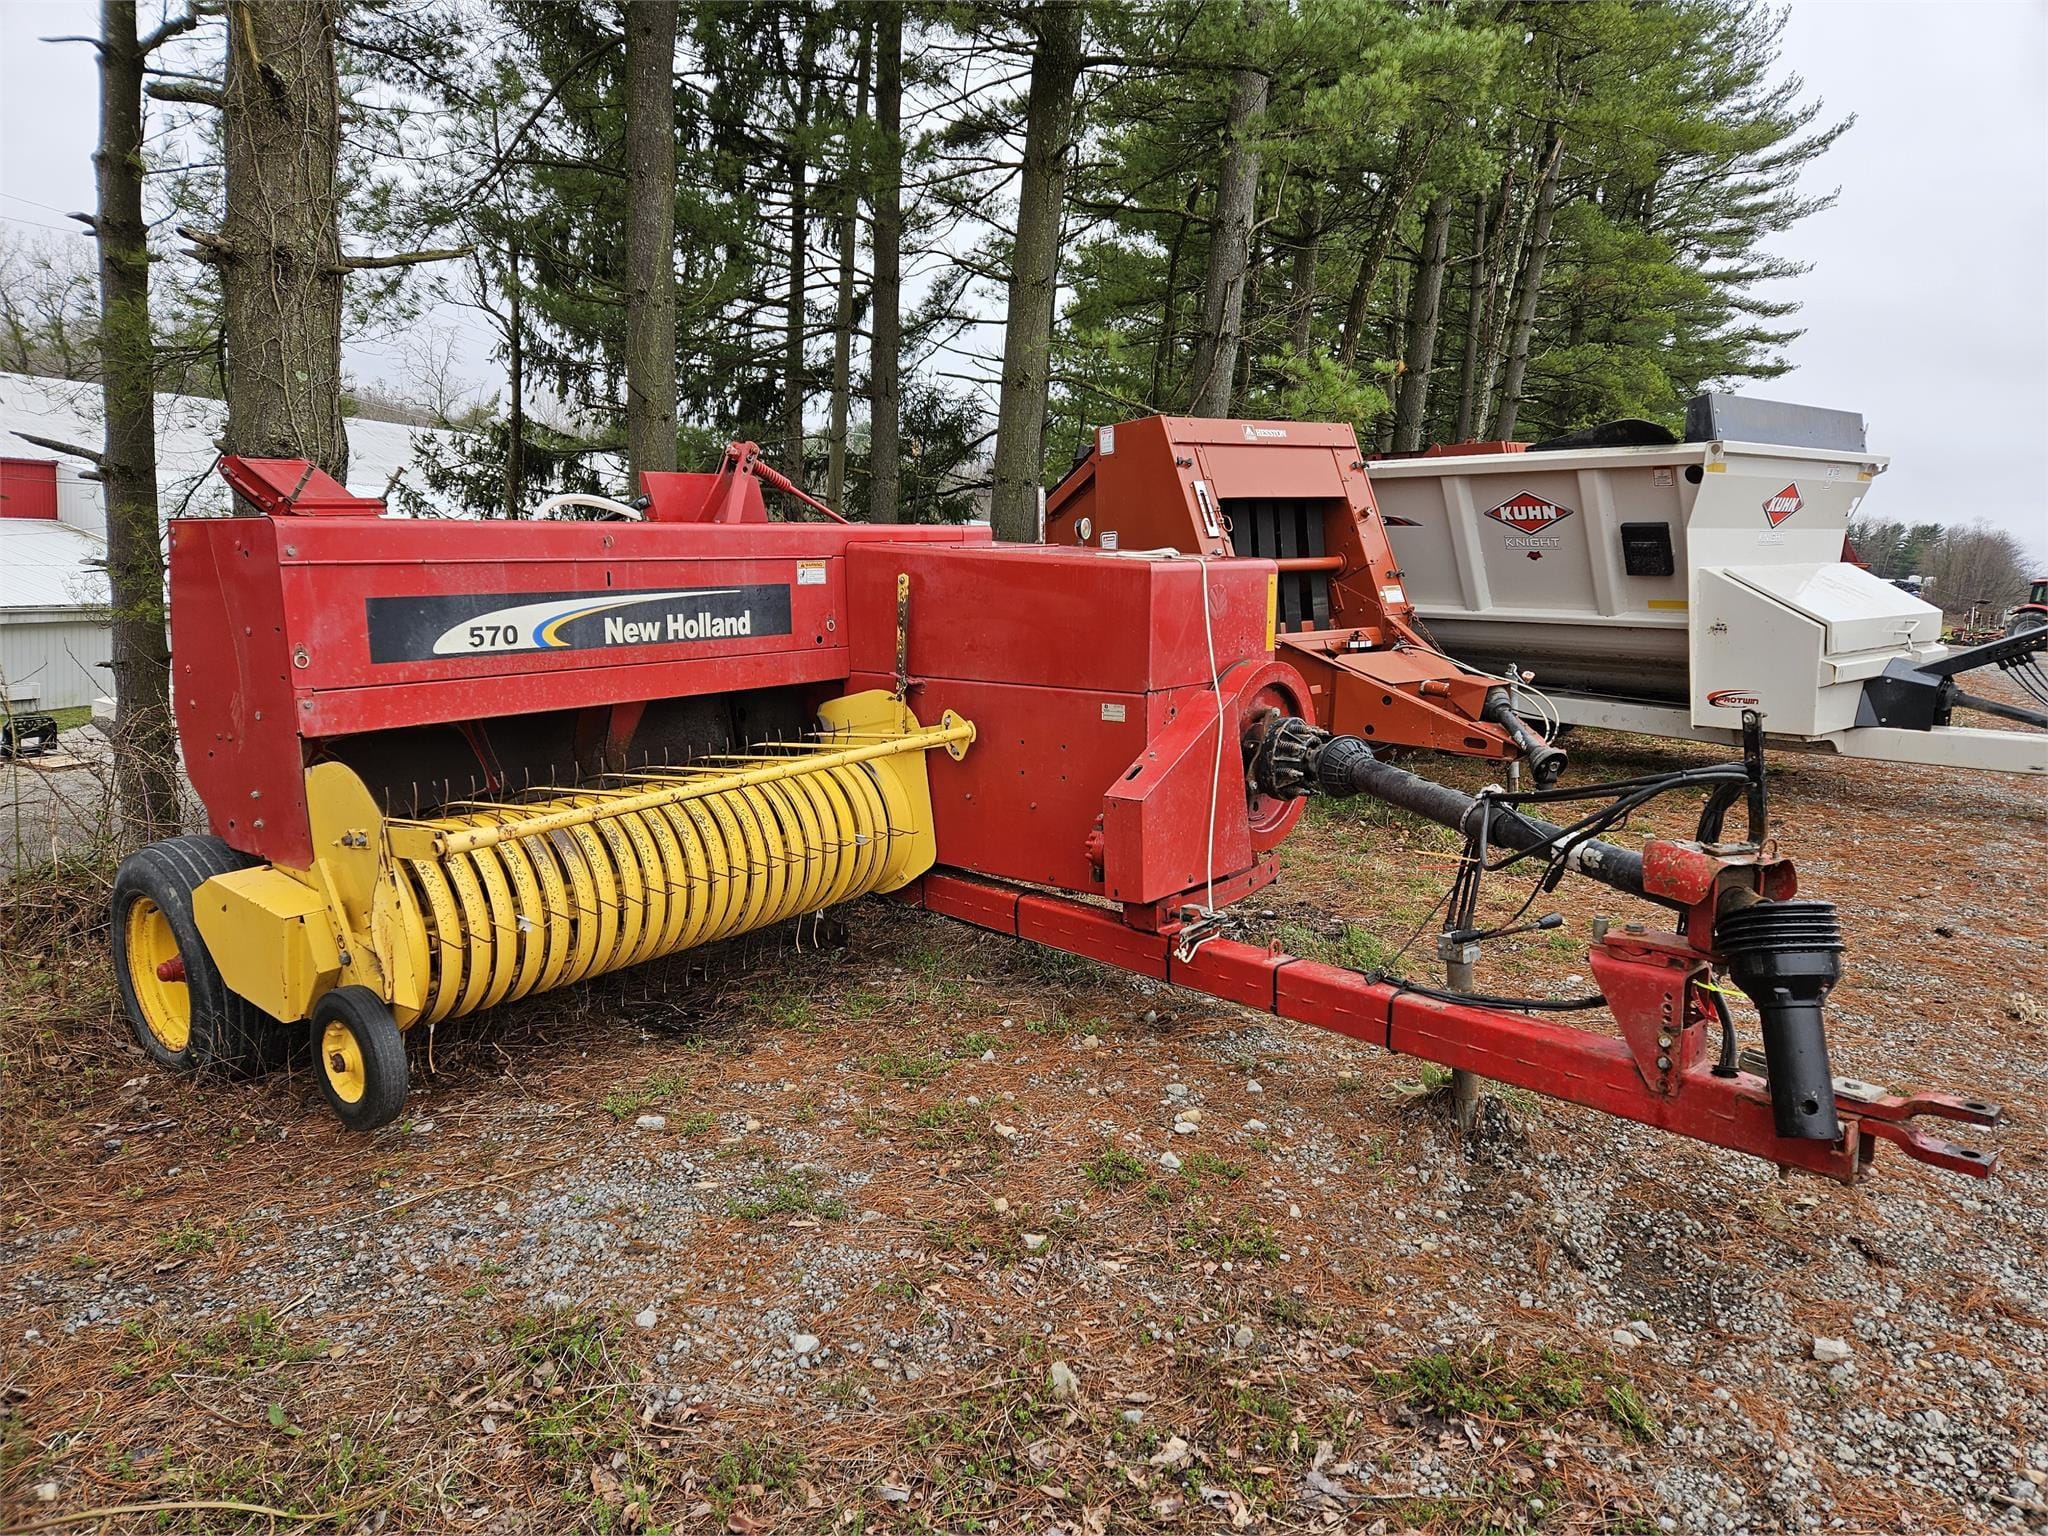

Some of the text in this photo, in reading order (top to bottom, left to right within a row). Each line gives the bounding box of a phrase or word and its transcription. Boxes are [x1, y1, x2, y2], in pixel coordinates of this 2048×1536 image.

[1767, 496, 1800, 512] KUHN
[1500, 505, 1557, 520] KUHN
[1505, 537, 1560, 548] KNIGHT
[603, 609, 751, 645] New Holland
[468, 624, 518, 648] 570
